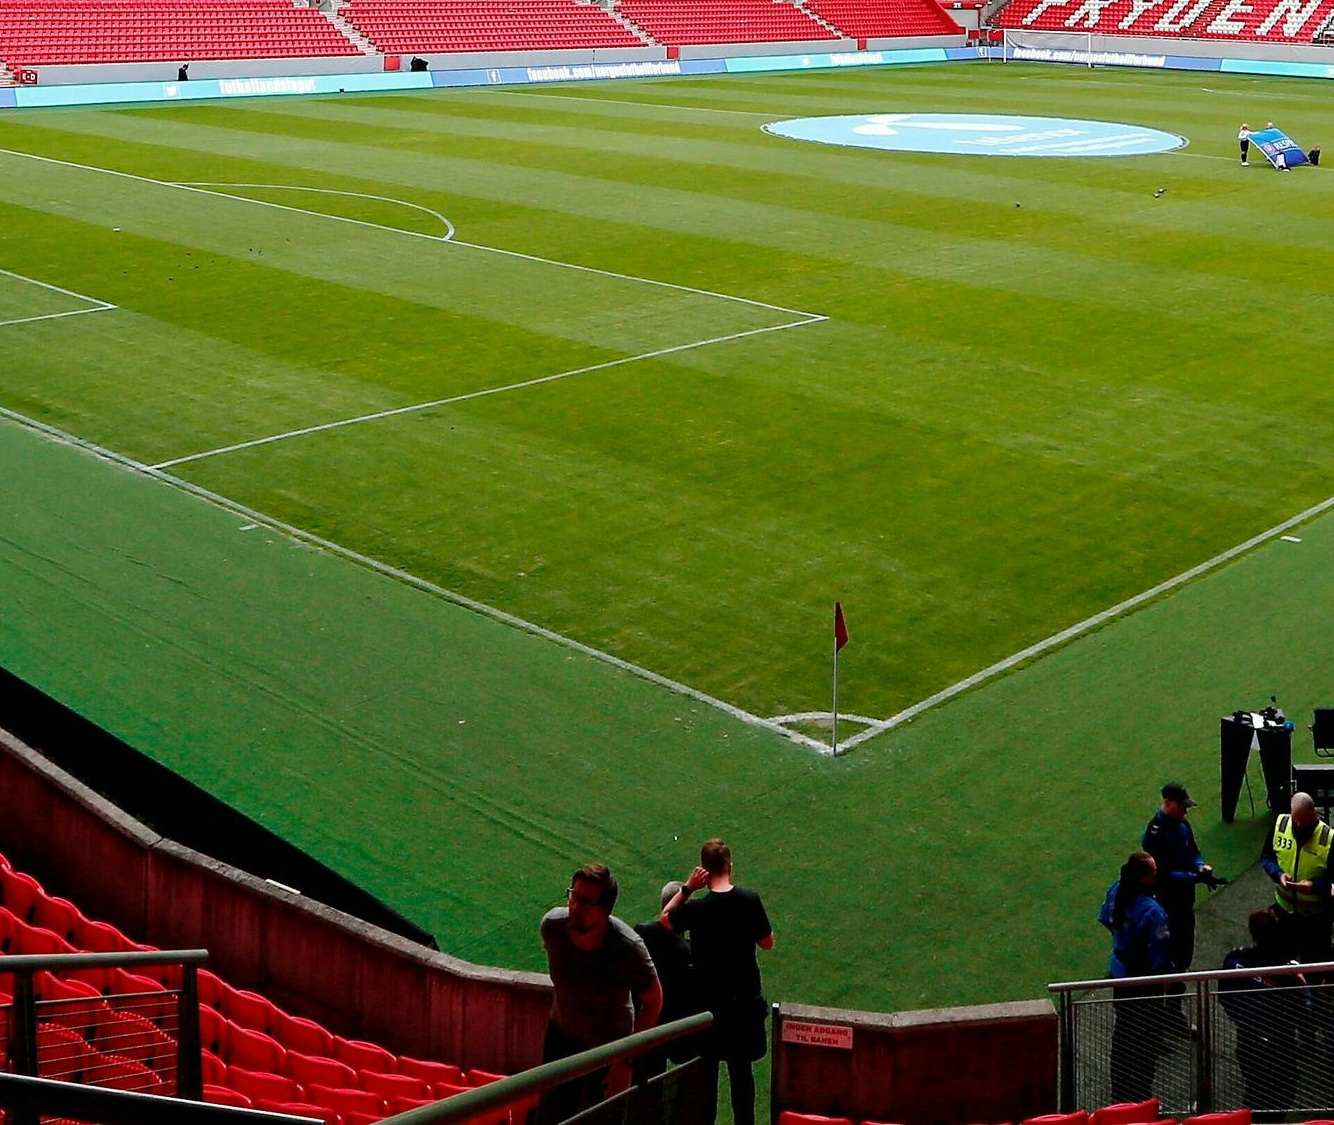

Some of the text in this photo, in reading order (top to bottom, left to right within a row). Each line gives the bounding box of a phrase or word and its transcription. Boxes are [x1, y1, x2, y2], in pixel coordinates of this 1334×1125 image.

[1277, 836, 1293, 851] 333
[786, 1023, 848, 1036] INGEN ADGANG
[796, 1035, 809, 1043] TIL
